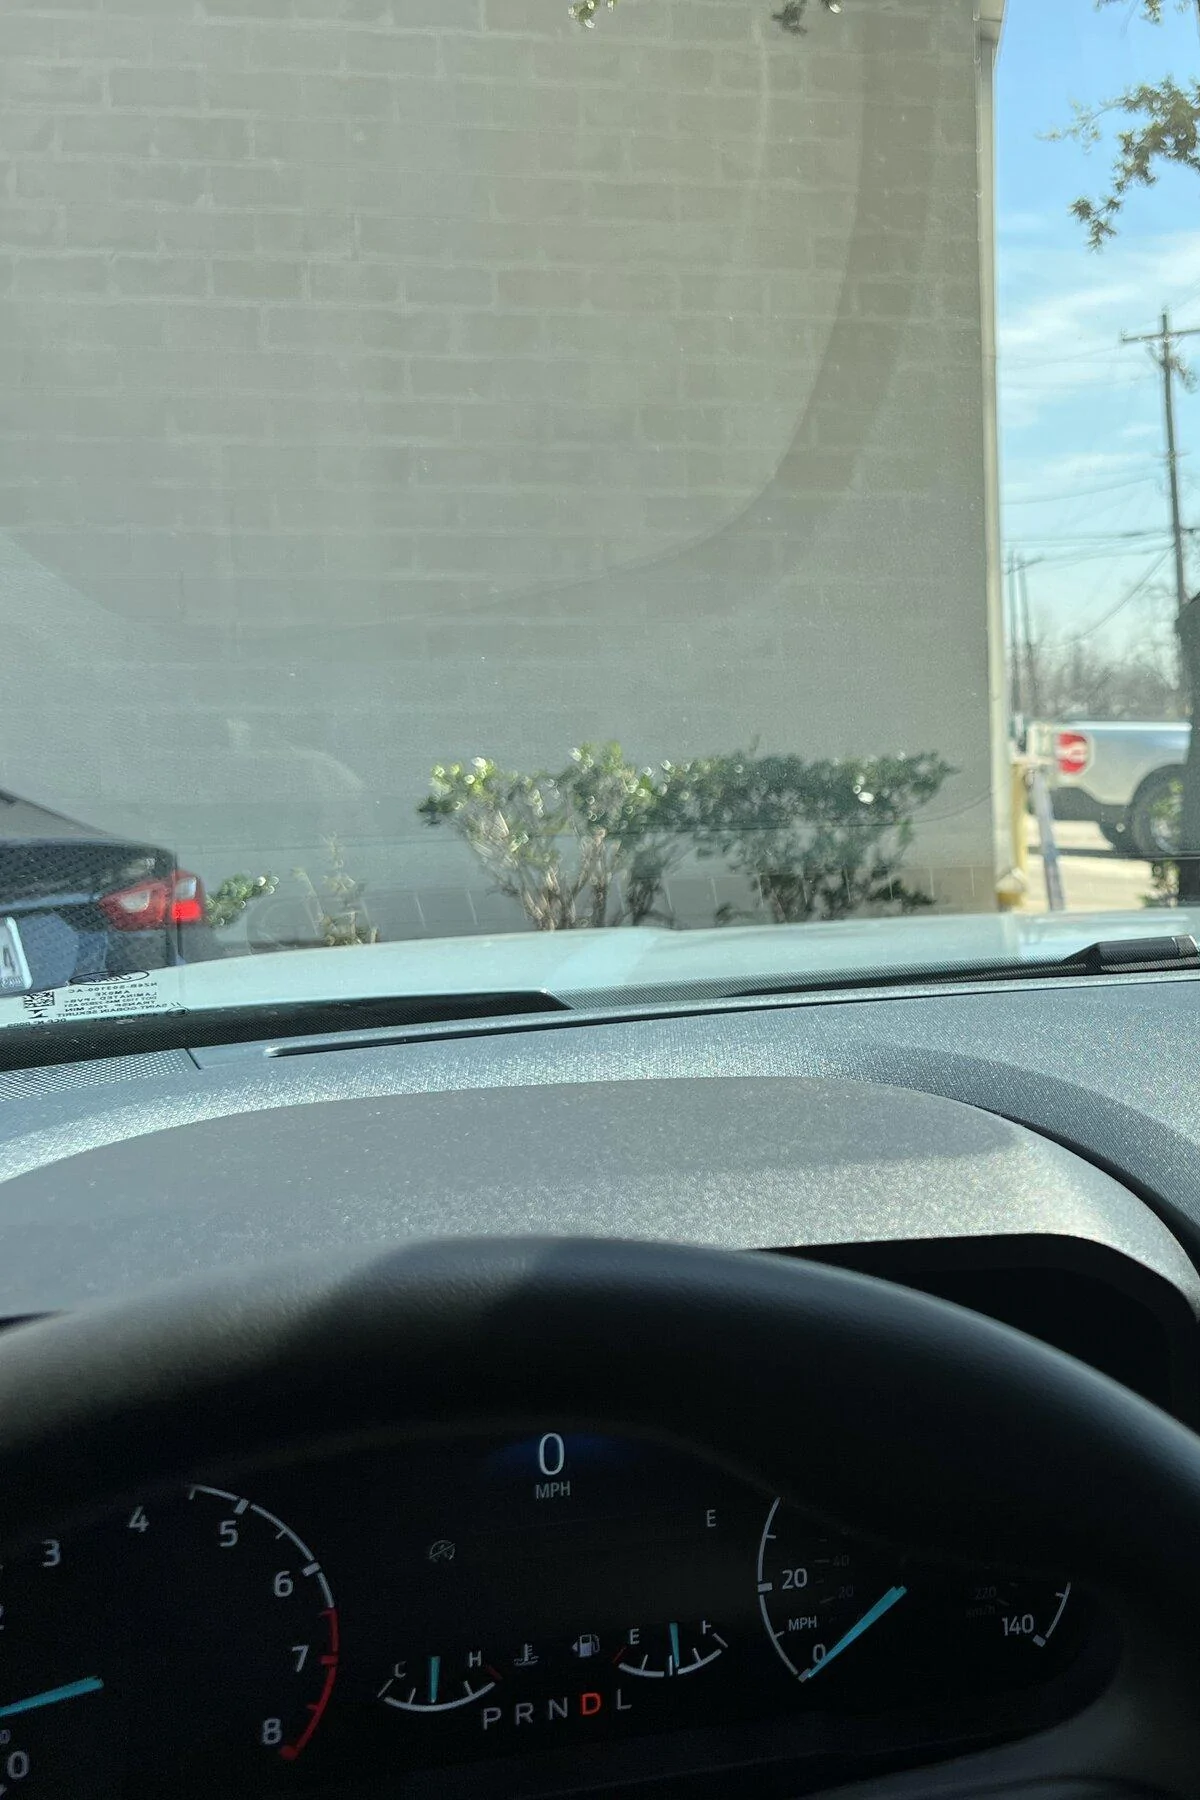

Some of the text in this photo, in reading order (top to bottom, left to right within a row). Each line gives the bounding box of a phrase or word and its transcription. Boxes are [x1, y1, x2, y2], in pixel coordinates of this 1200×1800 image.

[538, 1432, 565, 1476] 0
[535, 1480, 571, 1500] MPH
[128, 1506, 149, 1531] 4
[706, 1509, 717, 1528] E
[219, 1521, 239, 1548] 5
[43, 1539, 61, 1568] 3
[273, 1571, 294, 1597] 6
[781, 1567, 808, 1590] 20
[788, 1614, 818, 1631] MPH
[1000, 1613, 1035, 1637] 140
[629, 1628, 640, 1645] E
[291, 1645, 310, 1672] 7
[468, 1650, 482, 1669] H
[811, 1643, 827, 1665] 0
[394, 1661, 407, 1679] C
[482, 1688, 632, 1730] P R N D L
[262, 1718, 283, 1746] 8
[7, 1750, 30, 1780] 0
